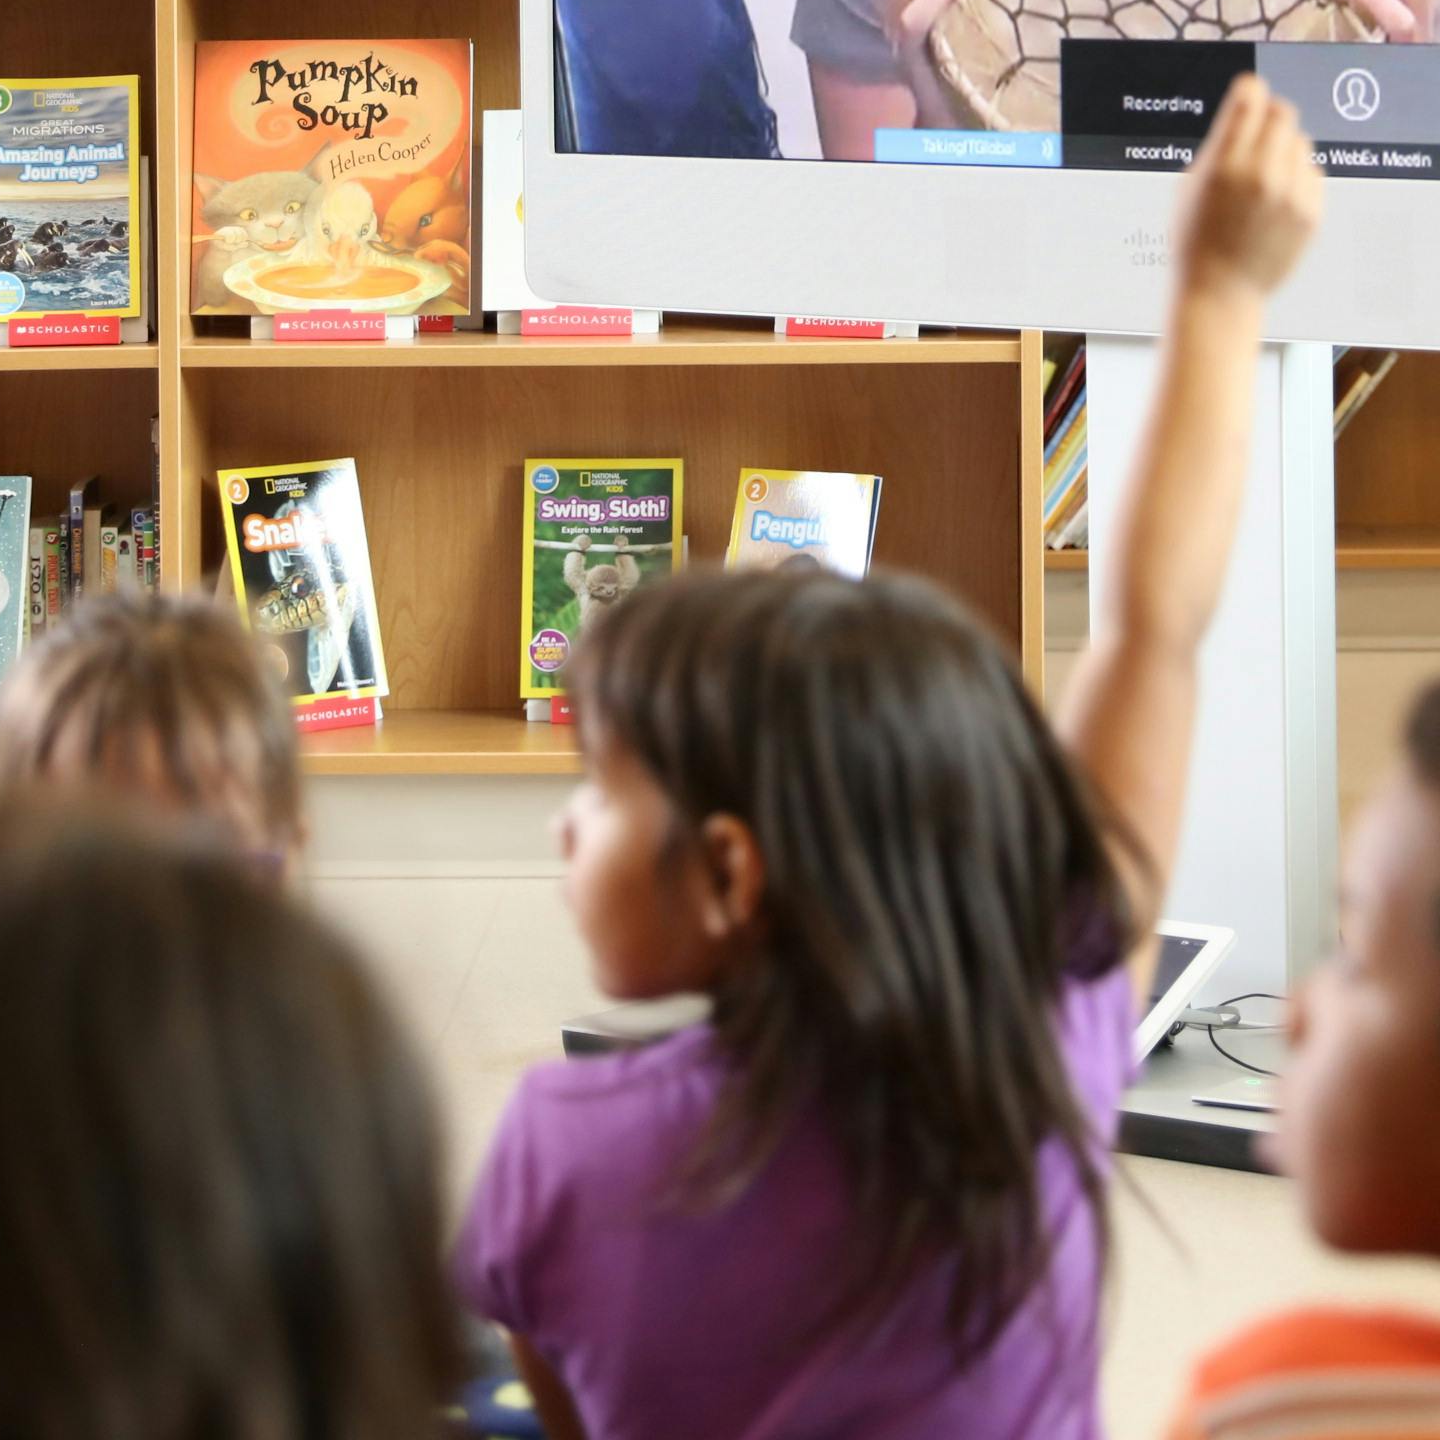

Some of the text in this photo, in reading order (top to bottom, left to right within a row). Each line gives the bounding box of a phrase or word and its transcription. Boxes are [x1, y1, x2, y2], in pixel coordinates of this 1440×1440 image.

[250, 51, 418, 105] Pumpkin
[1123, 95, 1203, 115] Recording
[293, 92, 389, 140] Soup
[13, 124, 105, 136] MIGRATIONS
[66, 144, 124, 161] Animal
[922, 138, 1016, 157] TakingITGlobal
[1126, 145, 1192, 164] recording
[330, 132, 434, 180] Helen Cooper
[1330, 150, 1376, 167] WebEx
[1380, 152, 1431, 168] Meetin
[20, 165, 97, 182] Journeys
[1130, 253, 1169, 266] CISC
[291, 319, 384, 330] SCHOLASTIC
[540, 314, 632, 325] SCHOLASTIC
[805, 318, 876, 327] SCHOLASTIC
[28, 324, 110, 333] SCHOLASTIC
[275, 477, 299, 485] NATIONAL
[275, 483, 307, 492] GEOGRAPHIC
[232, 484, 242, 499] 2
[606, 485, 624, 493] KIDS
[751, 483, 761, 498] 2
[542, 499, 667, 522] Swing, Sloth!
[561, 526, 643, 535] Explore the Rain Forest
[753, 512, 823, 544] Pengu
[304, 706, 369, 721] SCHOLASTIC
